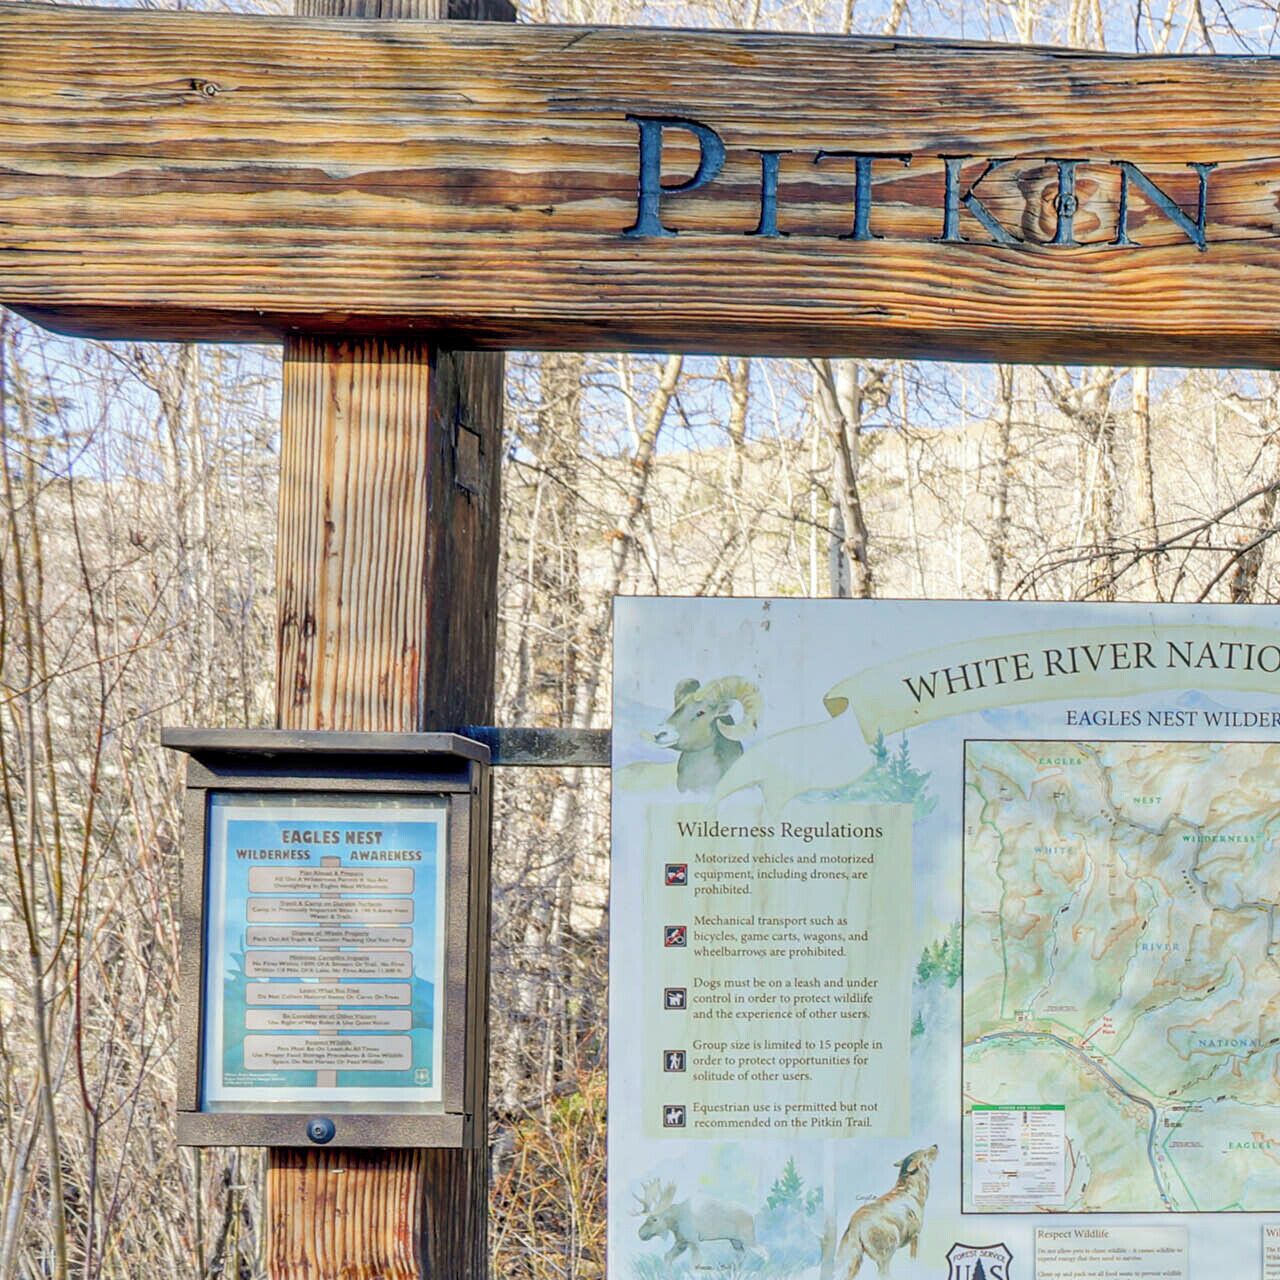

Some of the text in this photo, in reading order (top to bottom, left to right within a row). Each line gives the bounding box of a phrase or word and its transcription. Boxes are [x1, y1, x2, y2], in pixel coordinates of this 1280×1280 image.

[622, 113, 1221, 253] PITKIN
[901, 652, 1034, 705] WHITE
[1042, 640, 1155, 678] RIVER
[1066, 709, 1142, 727] EAGLES
[1146, 710, 1199, 728] NEST
[282, 829, 383, 846] EAGLES NEST
[676, 820, 884, 844] Wilderness Regulations
[236, 849, 422, 862] WILDERNESS AWARENESS
[694, 852, 875, 865] Motorized vehicles and motorized
[693, 867, 869, 883] equipment, including drones, are
[693, 883, 753, 898] prohibited.
[693, 914, 848, 929] Mechanical transport such as
[692, 929, 869, 945] bicycles, game carts, wagons, and
[693, 945, 847, 960] wheelbarrows are prohibited.
[692, 976, 879, 991] Dogs must be on a leash and under
[692, 991, 874, 1007] control in order to protect wildlife
[692, 1006, 871, 1022] and the experience of other users.
[692, 1038, 884, 1053] Group size is limited to 15 people in
[690, 1053, 870, 1069] order to protect opportunities for
[692, 1069, 813, 1082] solitude of other users.
[692, 1100, 878, 1116] Equestrian use is permitted but not
[694, 1115, 873, 1128] recommended on the Pitkin Trail.
[1035, 1228, 1110, 1241] Respect Wildlife
